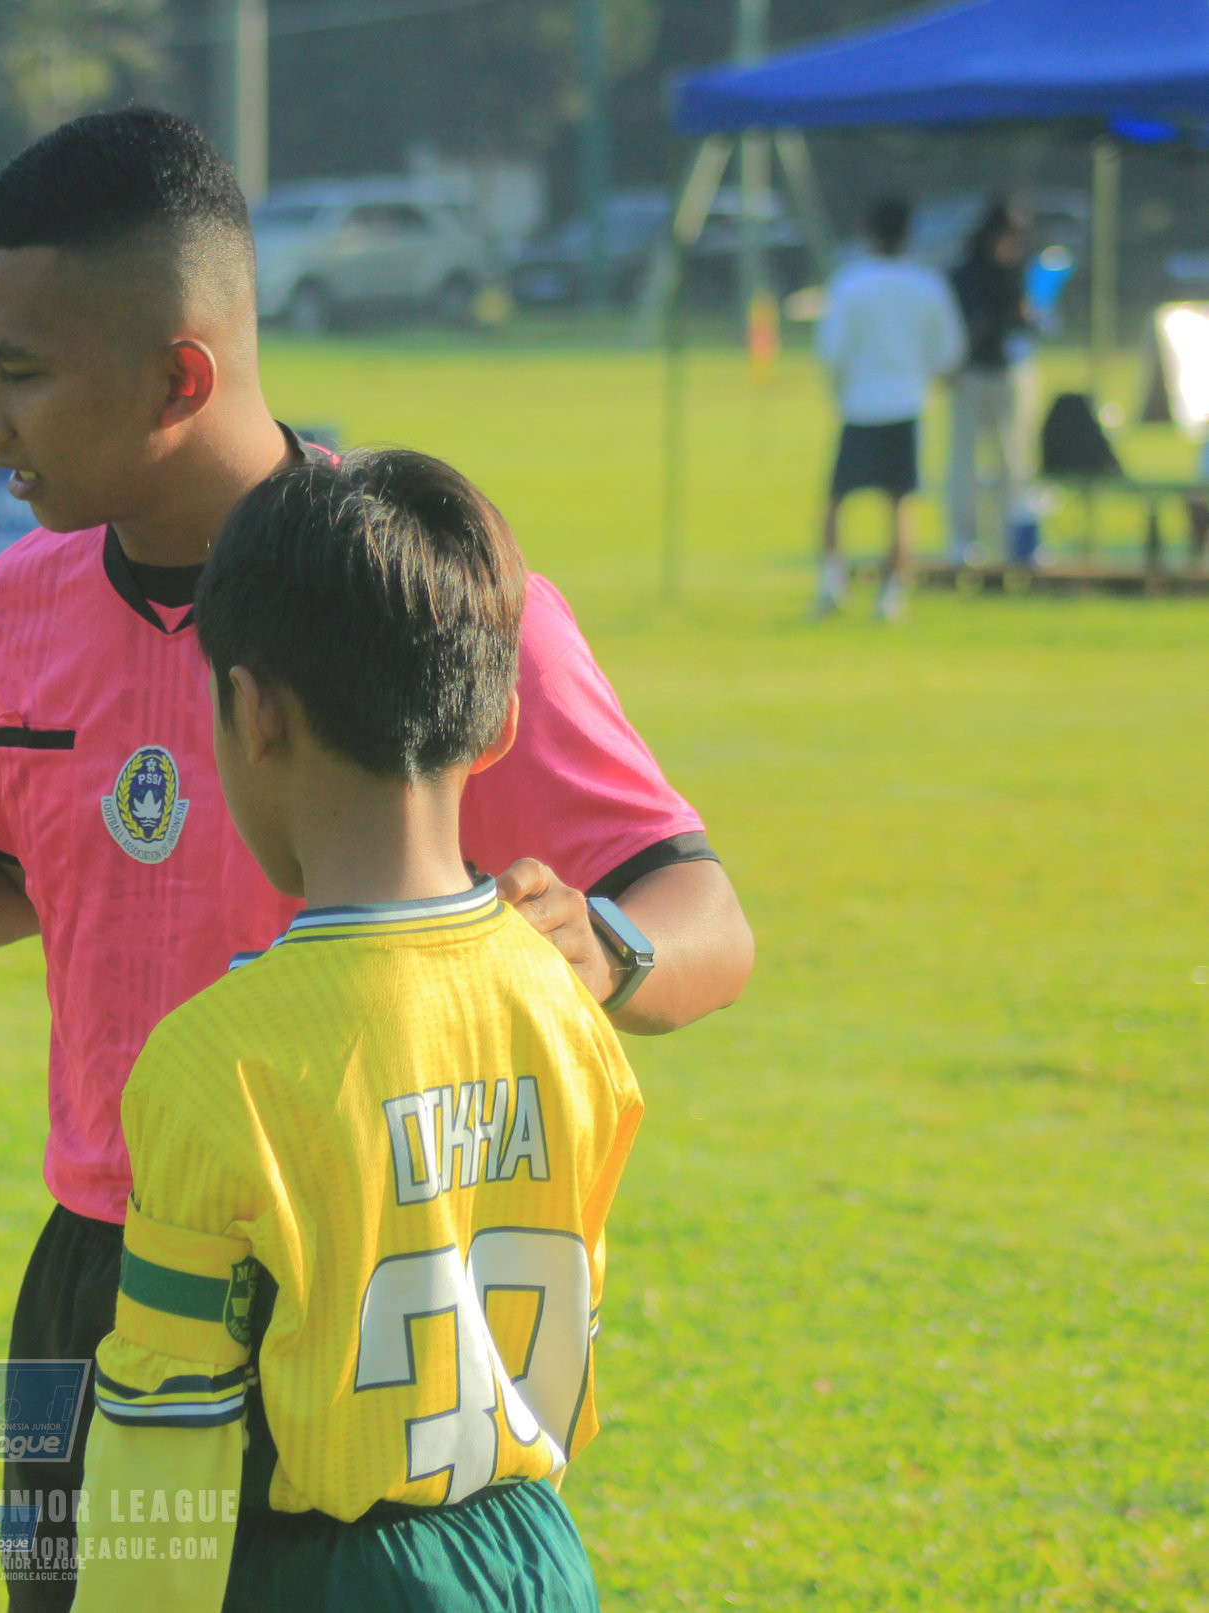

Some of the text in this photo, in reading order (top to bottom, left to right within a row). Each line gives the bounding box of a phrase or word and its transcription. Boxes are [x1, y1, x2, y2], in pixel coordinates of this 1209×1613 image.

[137, 773, 162, 785] PSSI
[103, 798, 124, 841] FOOTBALL
[167, 801, 188, 844] INDONESIA
